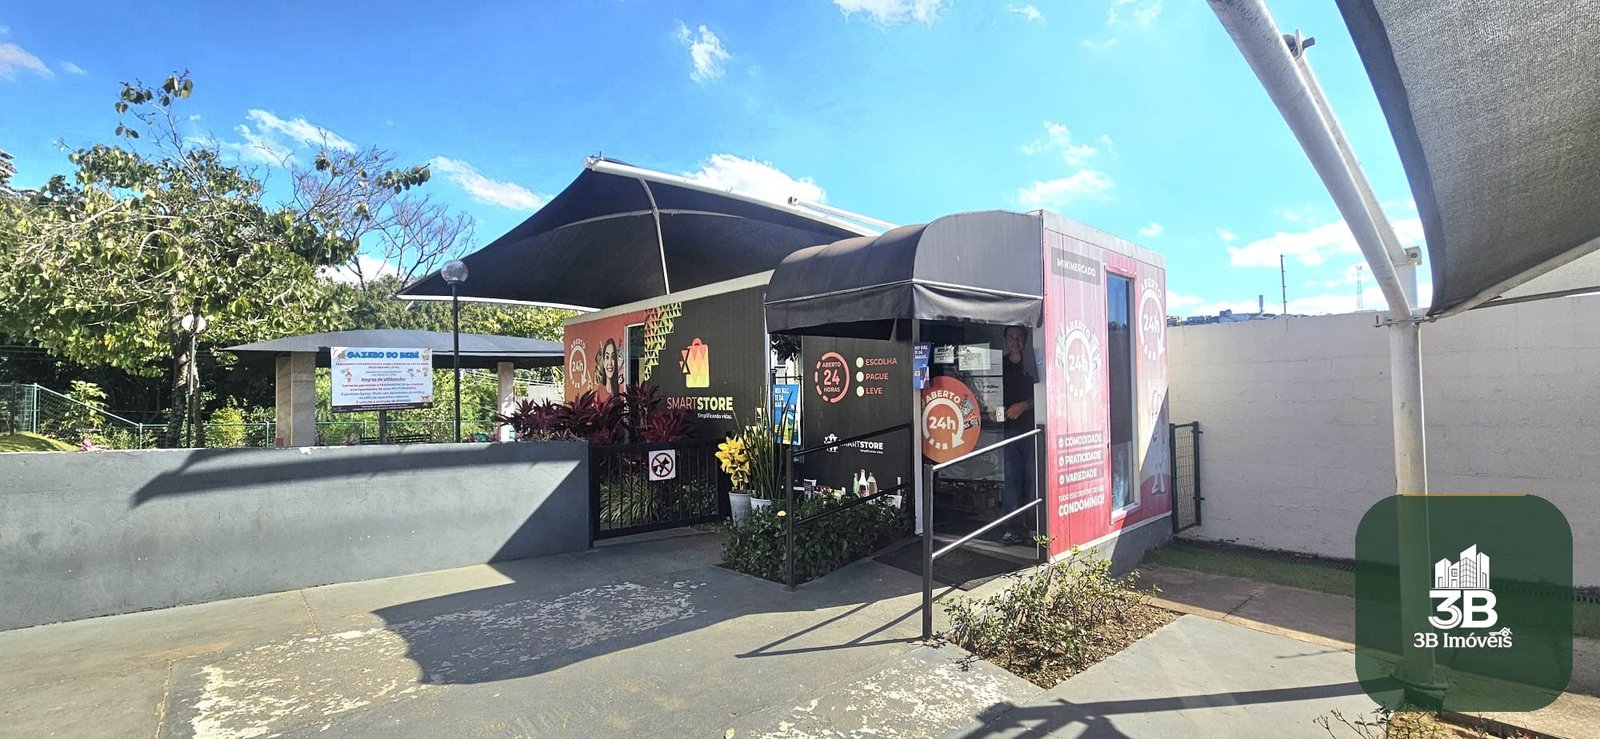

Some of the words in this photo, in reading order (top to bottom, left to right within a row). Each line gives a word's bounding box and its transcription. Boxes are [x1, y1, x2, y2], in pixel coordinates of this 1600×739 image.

[1057, 258, 1096, 277] MINIMERCADO
[1143, 313, 1160, 333] 24h
[347, 351, 384, 359] GAZEBO
[386, 351, 398, 359] DO
[865, 357, 897, 366] ESCOLHA
[572, 360, 584, 372] 24h
[1069, 354, 1089, 372] 24h
[823, 369, 841, 386] 24
[865, 373, 889, 381] PAGUE
[865, 387, 883, 395] LEVE
[925, 389, 961, 404] ABERTO
[666, 396, 733, 411] SMARTSTORE
[929, 416, 956, 430] 24h
[1065, 432, 1102, 447] COMODIDADE
[1065, 450, 1102, 465] PRATICIDADE
[1065, 468, 1097, 483] VARIEDADE
